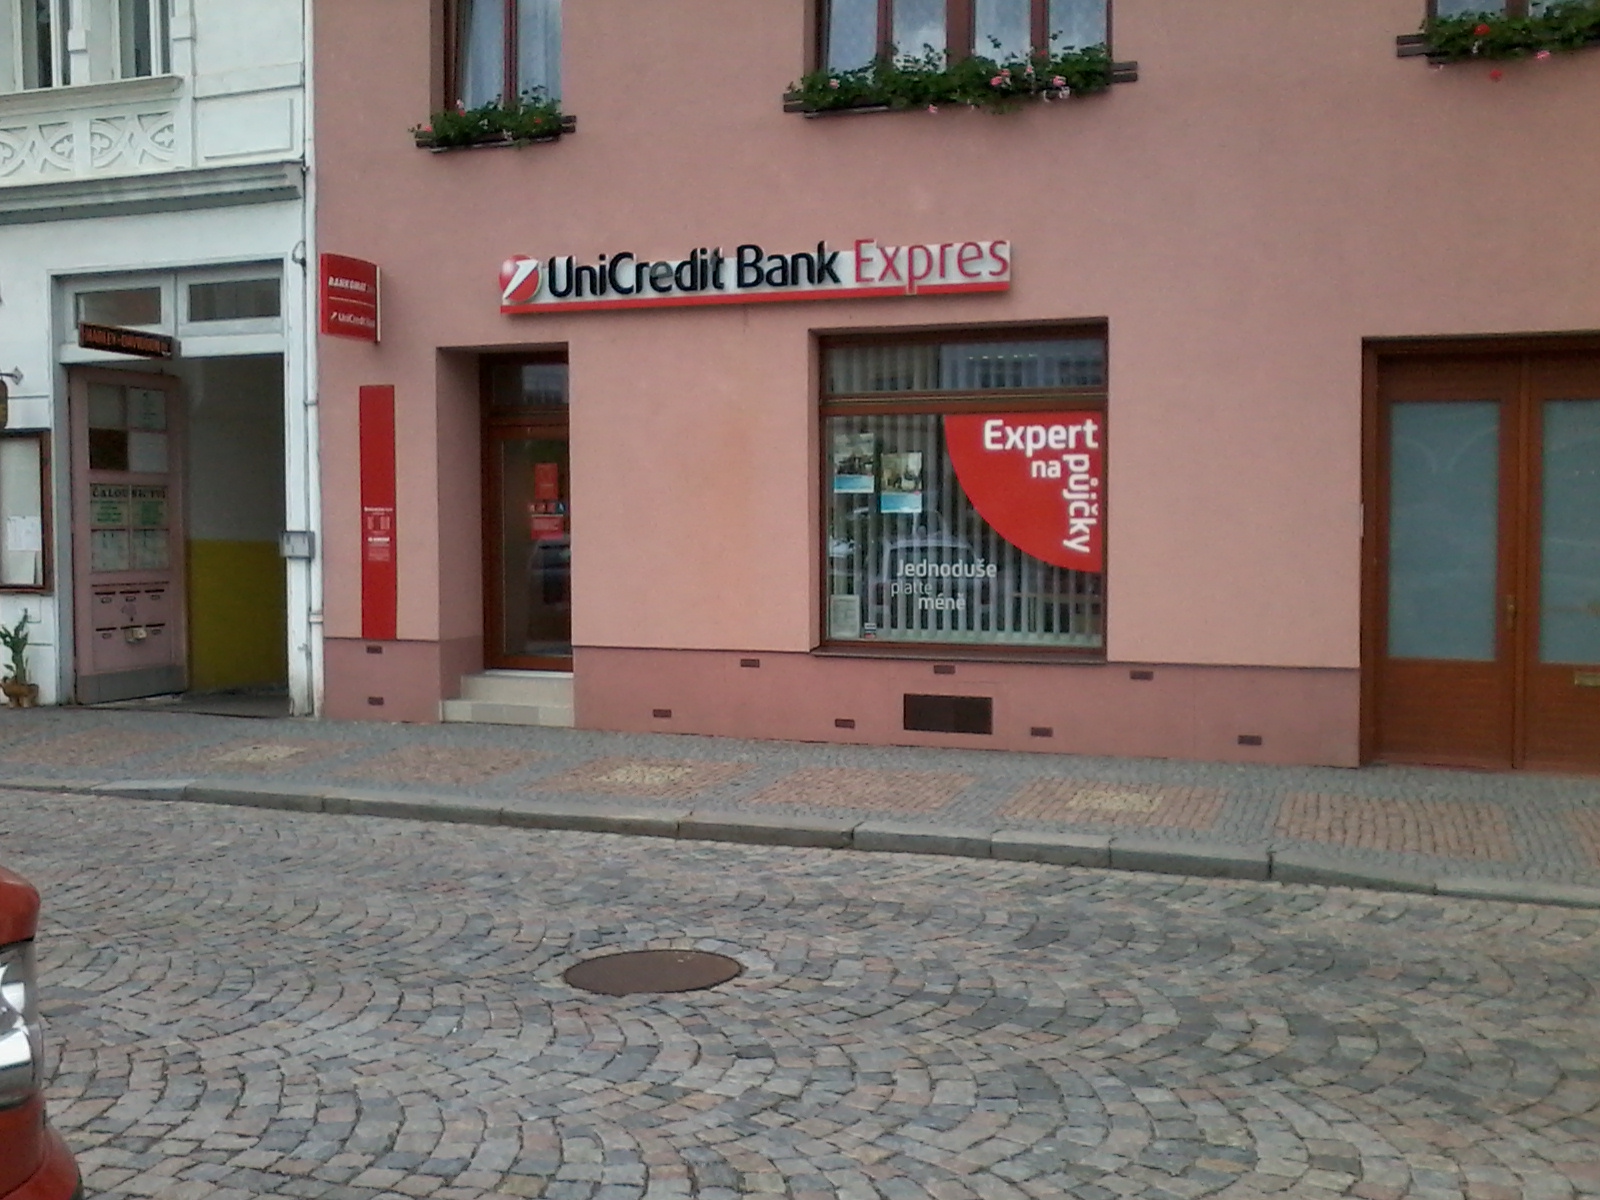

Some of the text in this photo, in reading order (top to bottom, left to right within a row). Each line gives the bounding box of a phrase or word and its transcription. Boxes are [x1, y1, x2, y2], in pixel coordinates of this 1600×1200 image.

[547, 238, 1010, 298] UniCredit Bank Expres
[983, 418, 1099, 457] Expert
[1031, 460, 1062, 478] na
[1062, 453, 1100, 554] půjčky
[896, 557, 998, 578] Jednoduše
[918, 591, 966, 610] méně
